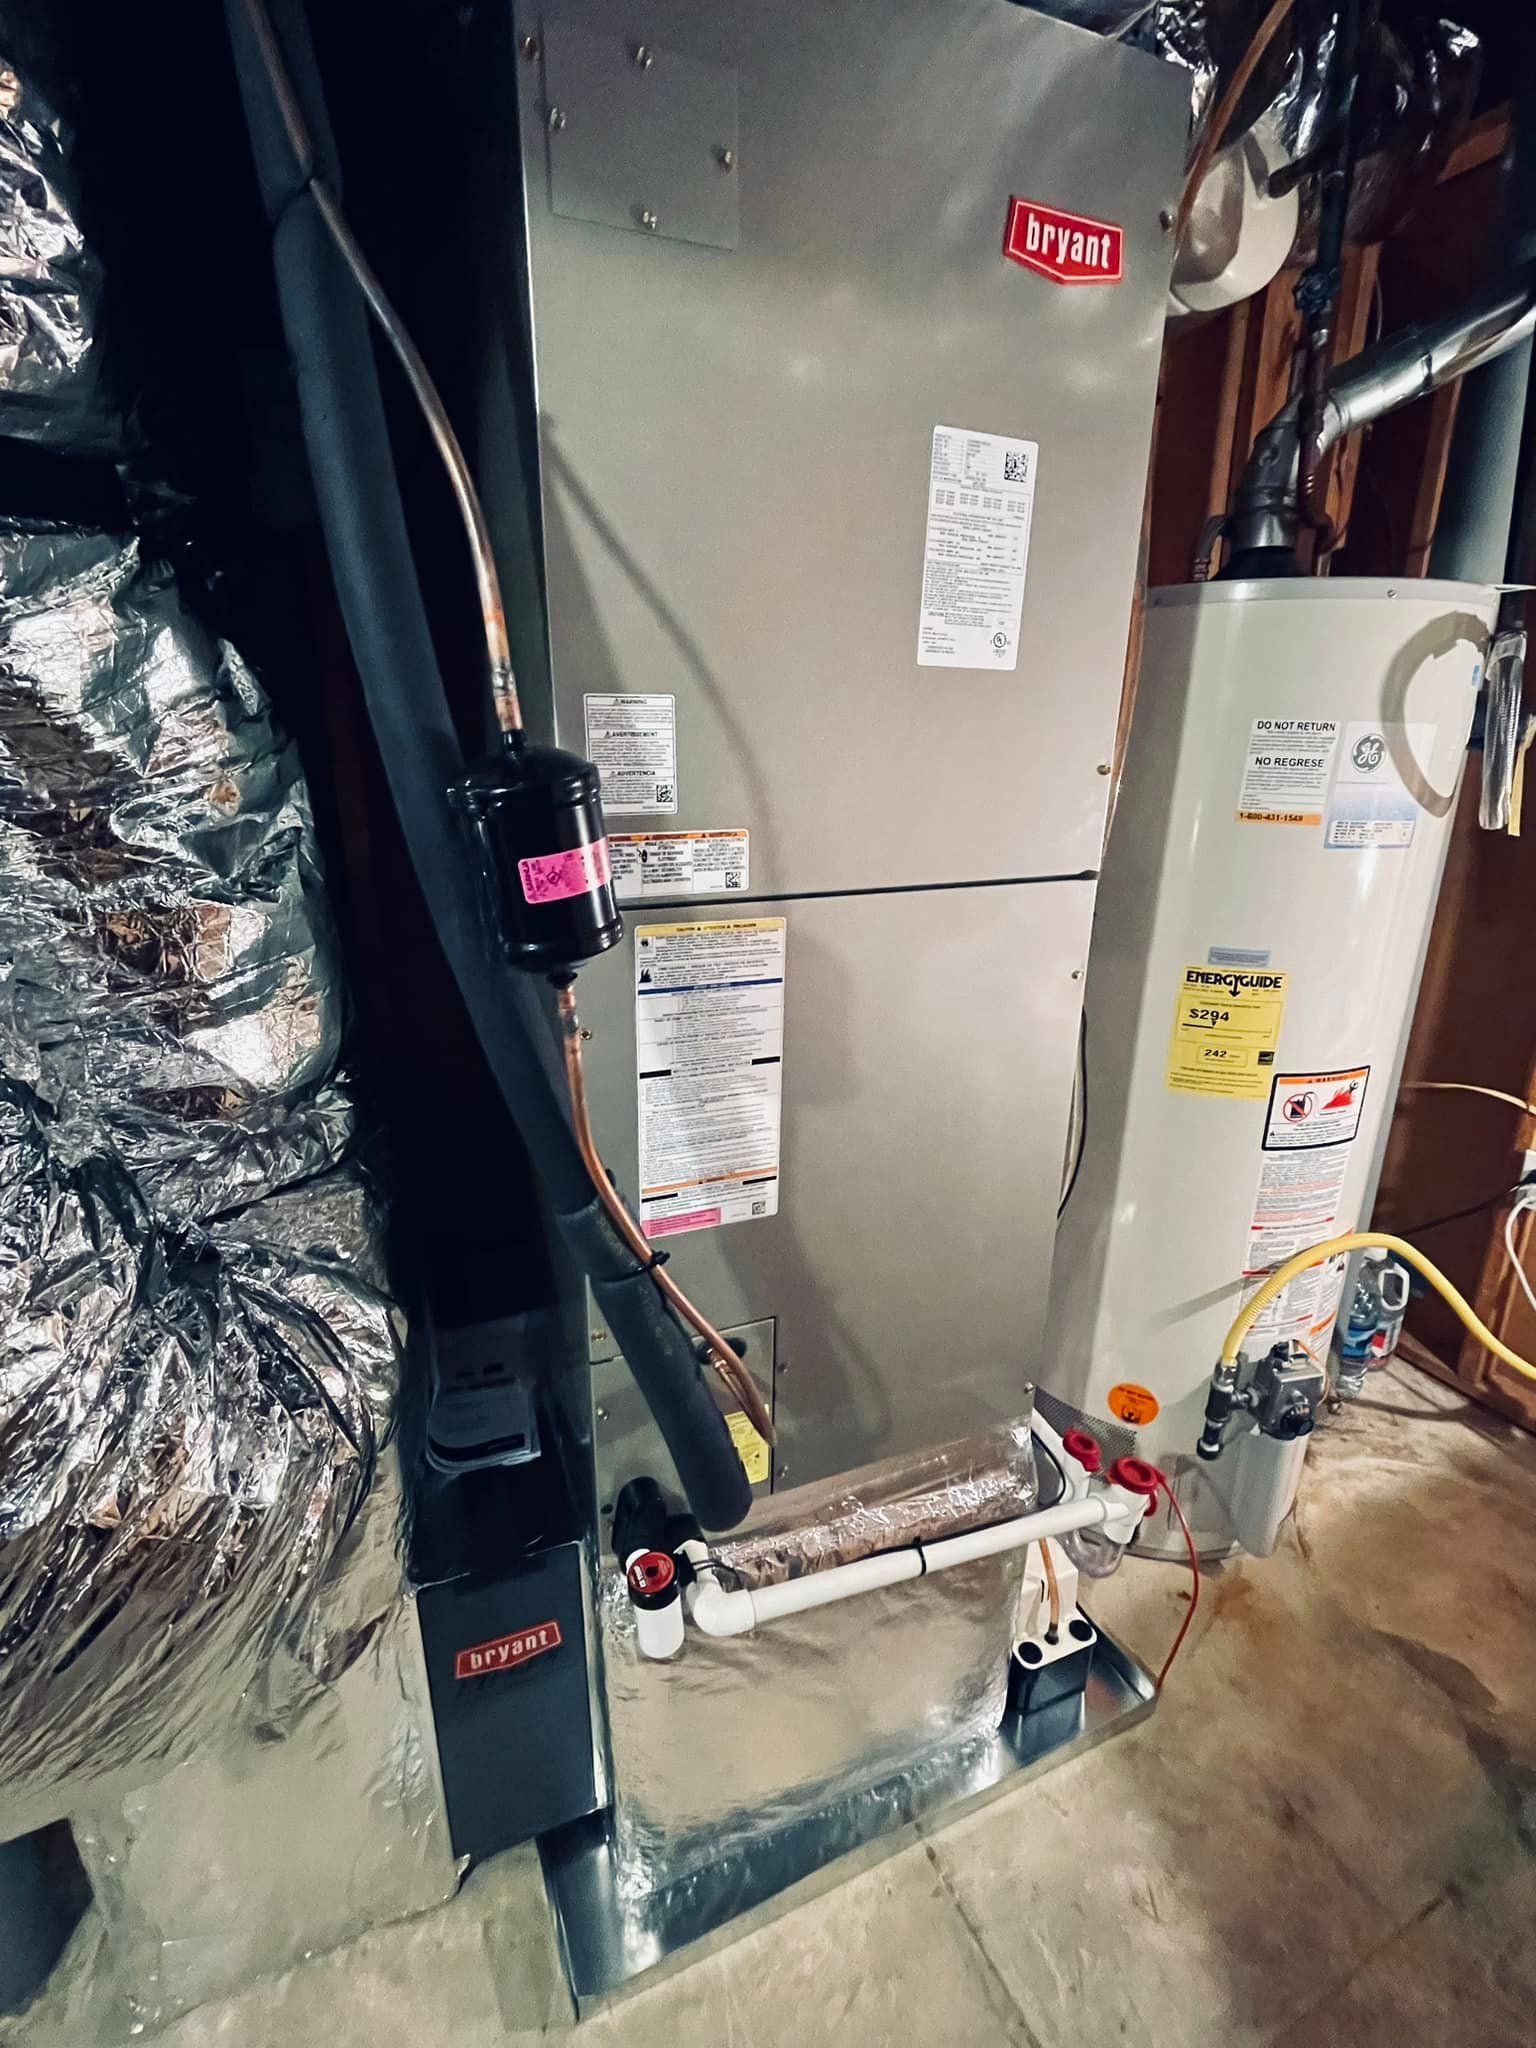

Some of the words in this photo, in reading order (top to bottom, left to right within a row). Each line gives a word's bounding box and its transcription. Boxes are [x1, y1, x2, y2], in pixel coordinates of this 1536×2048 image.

[1026, 212, 1111, 269] bryant
[1257, 720, 1272, 730] DO
[1275, 721, 1295, 731] NOT
[1297, 722, 1336, 732] RETURN
[1255, 757, 1271, 767] NO
[1274, 758, 1325, 768] REGRESE
[1204, 1048, 1228, 1059] 242
[470, 1630, 548, 1670] bryant
